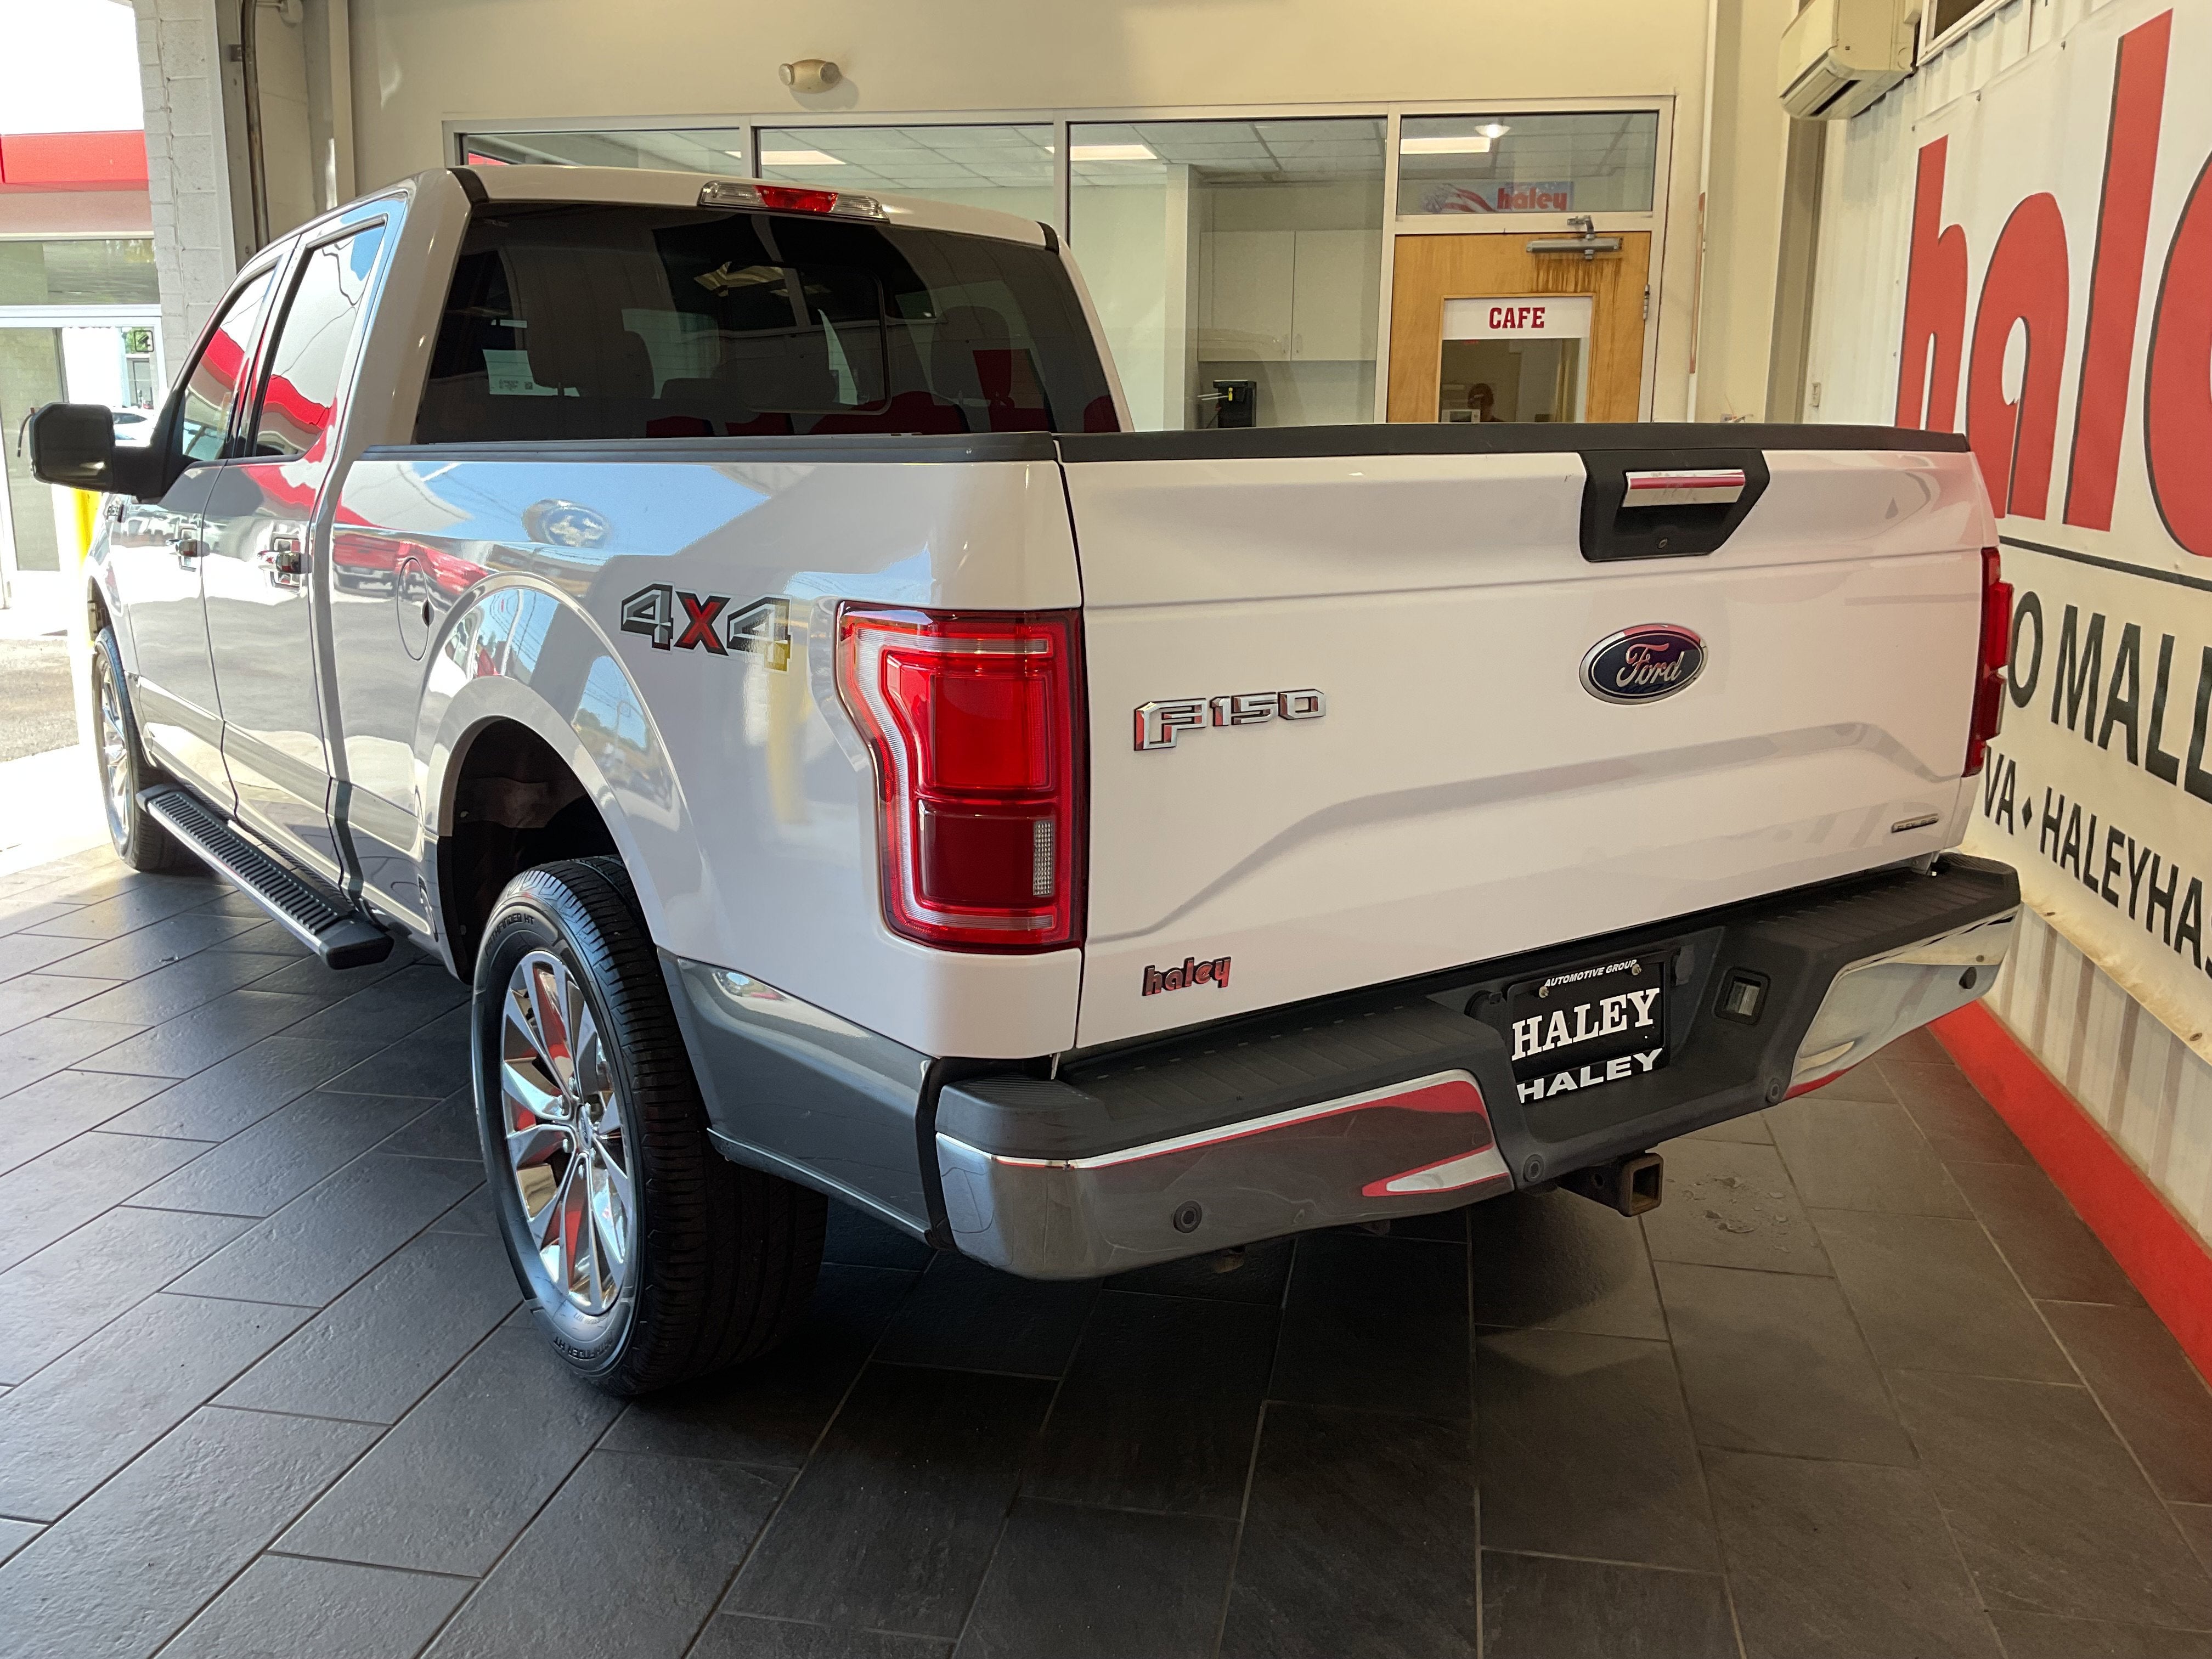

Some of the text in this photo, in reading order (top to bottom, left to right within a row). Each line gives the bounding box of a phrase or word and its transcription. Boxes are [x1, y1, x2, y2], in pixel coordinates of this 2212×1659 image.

[1497, 187, 1568, 211] haley
[1489, 307, 1545, 329] CAFE
[1616, 643, 1685, 687] Ford
[2040, 786, 2212, 980] HALEYHA
[1142, 956, 1231, 996] haley
[1544, 959, 1637, 987] AUTOMOTIVE GROUP
[1511, 988, 1660, 1061] HALEY
[1516, 1048, 1663, 1104] HALEY
